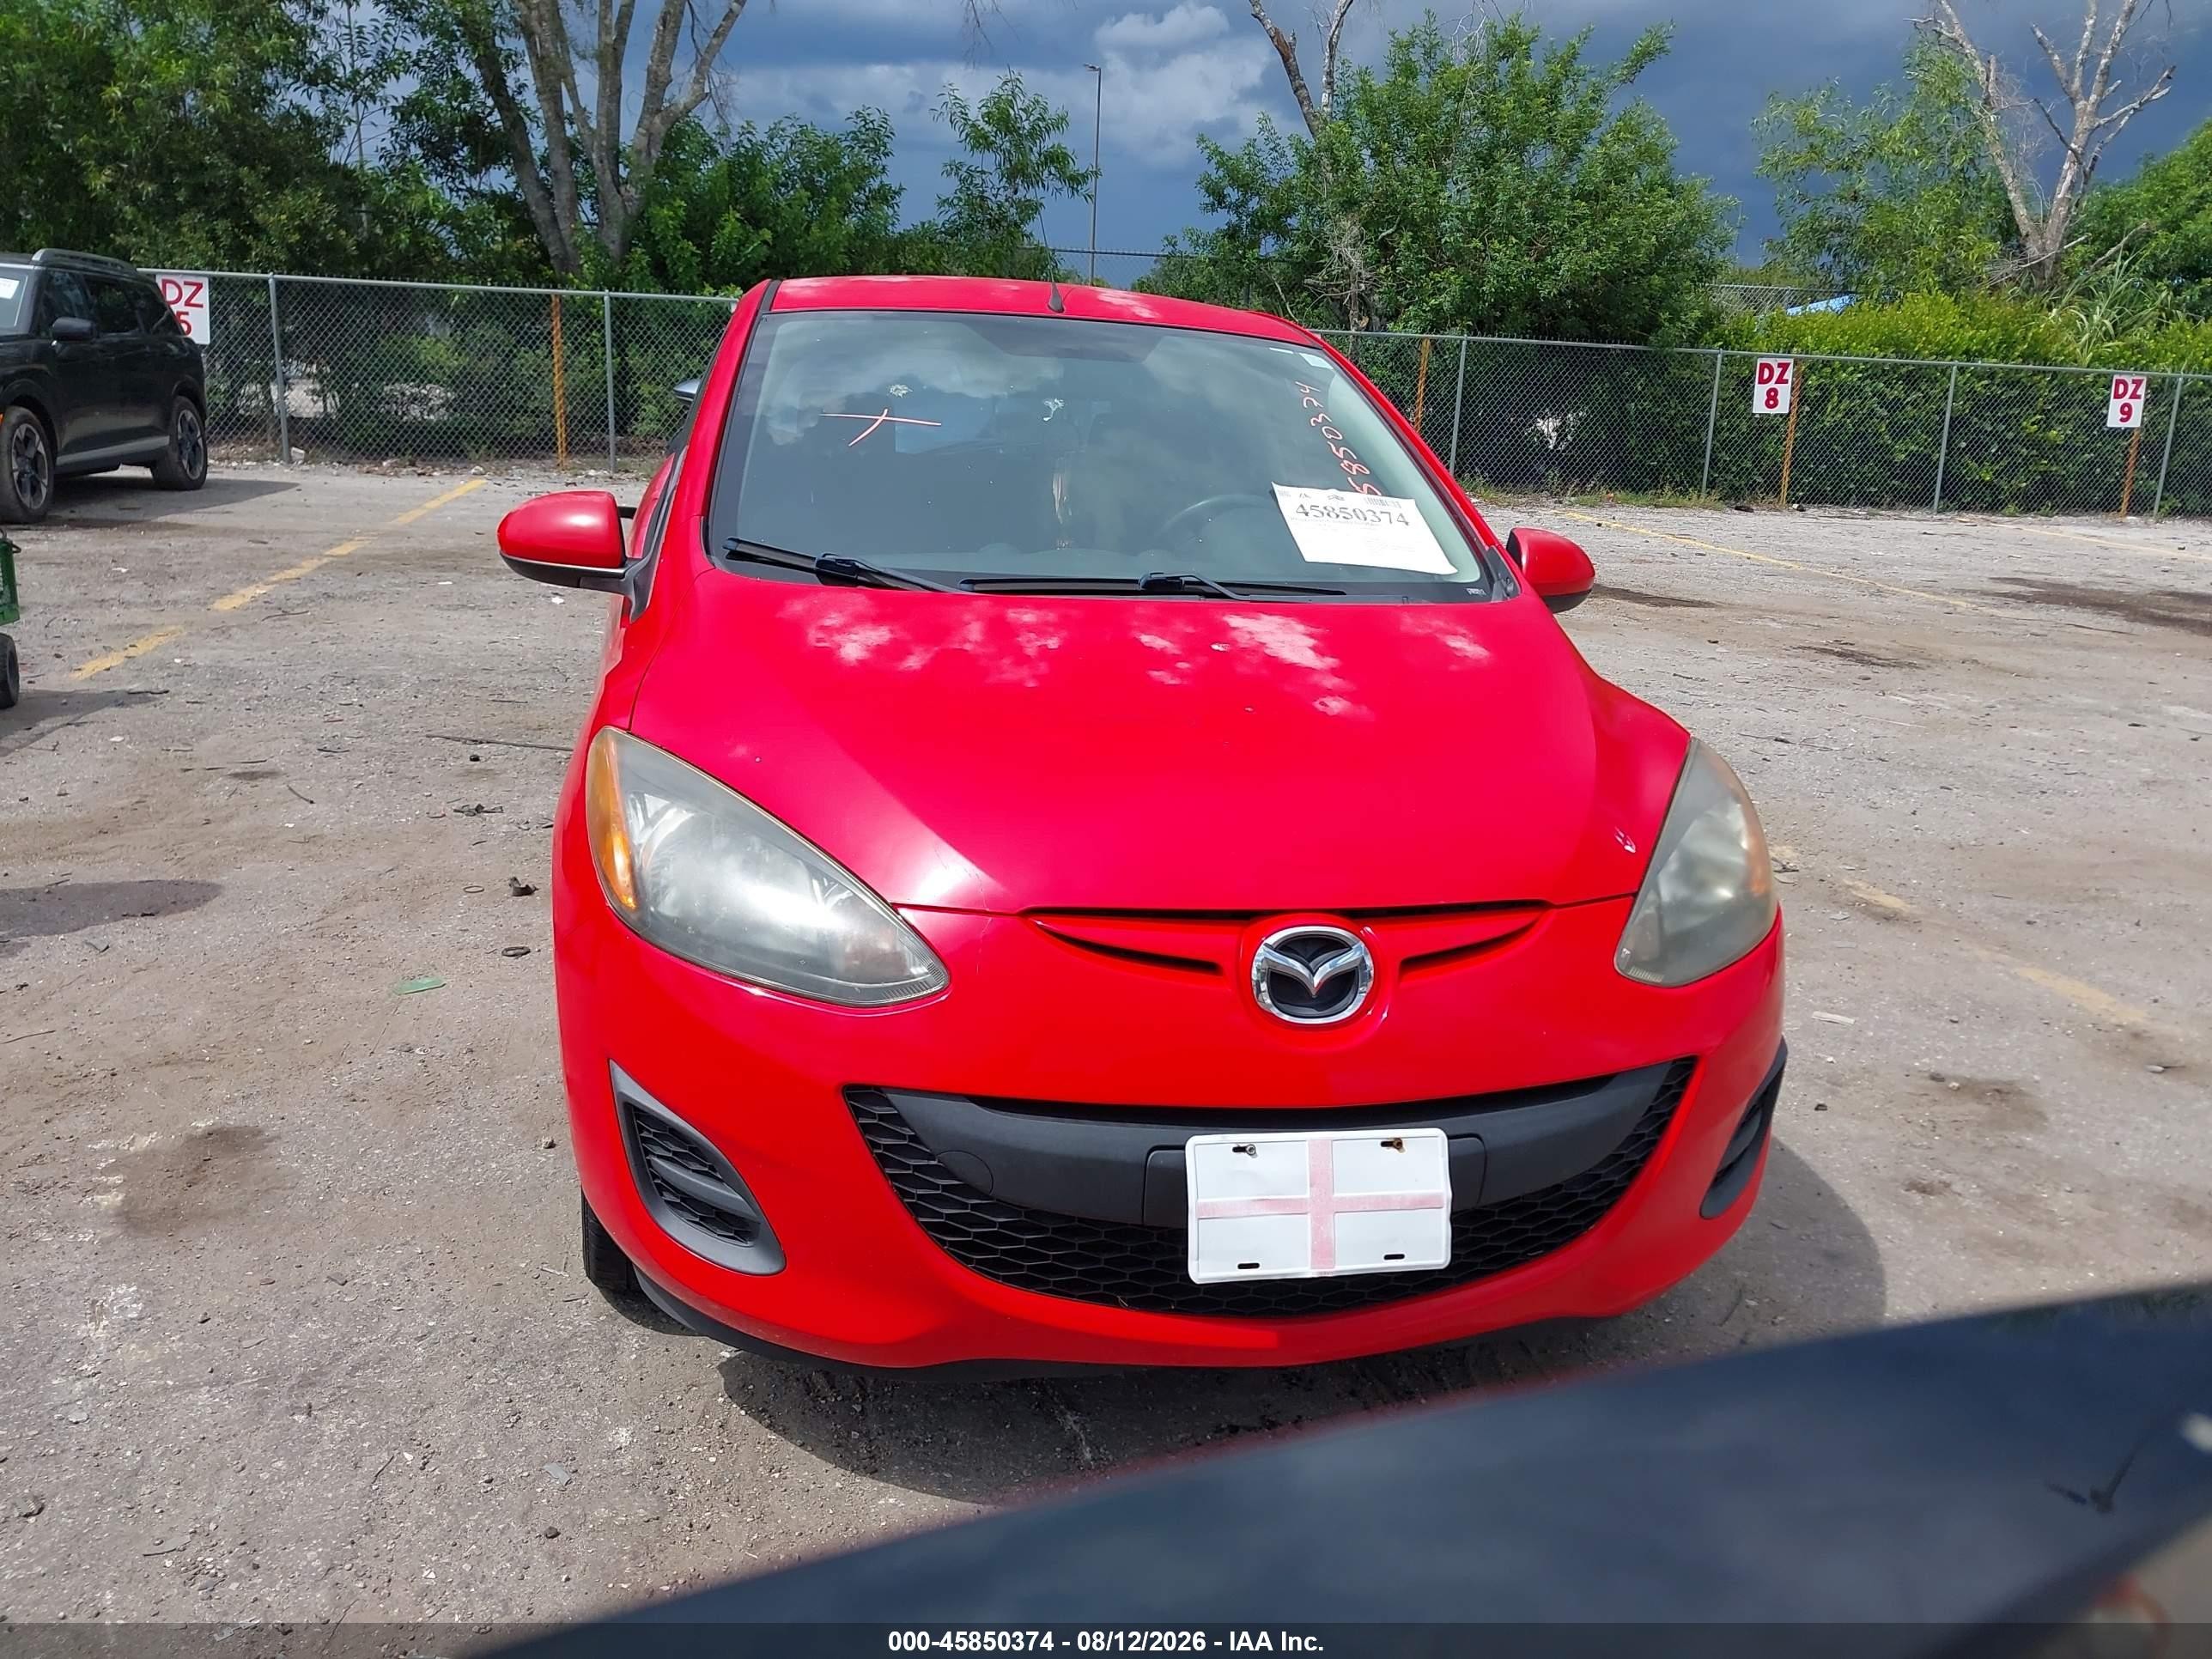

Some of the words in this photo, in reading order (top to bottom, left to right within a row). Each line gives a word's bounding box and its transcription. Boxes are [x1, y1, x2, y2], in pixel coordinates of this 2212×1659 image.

[161, 278, 204, 308] DZ
[176, 311, 191, 336] 5
[1757, 362, 1791, 385] DZ
[1765, 387, 1779, 410] 8
[2113, 378, 2144, 400] DZ
[2119, 402, 2133, 423] 9
[1295, 503, 1409, 526] 45850374
